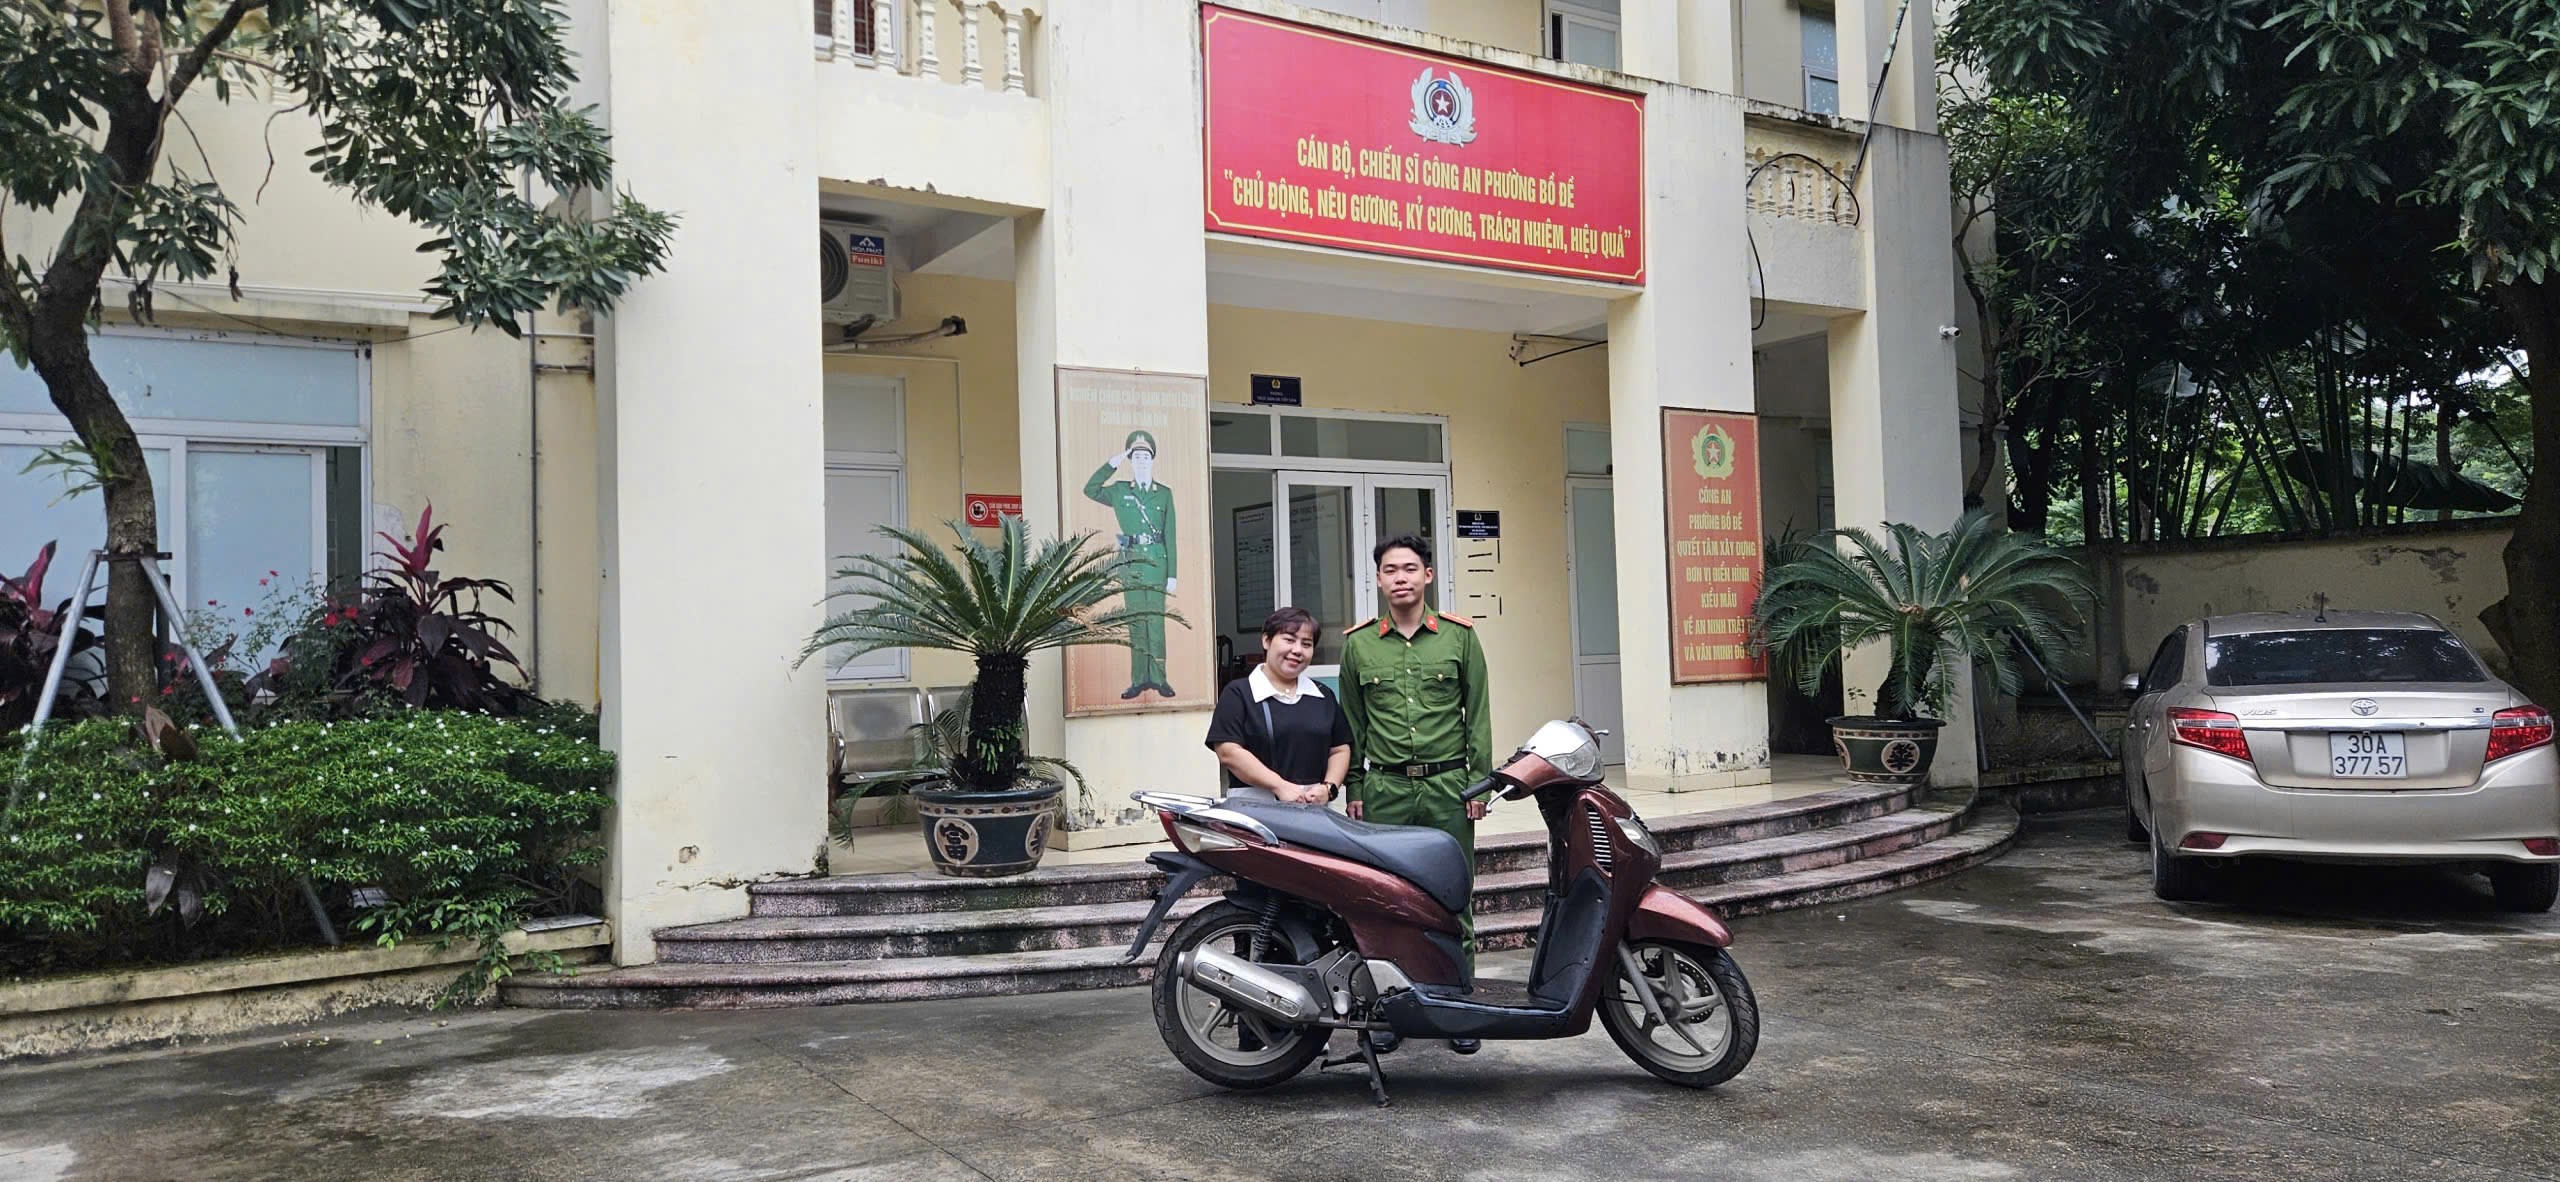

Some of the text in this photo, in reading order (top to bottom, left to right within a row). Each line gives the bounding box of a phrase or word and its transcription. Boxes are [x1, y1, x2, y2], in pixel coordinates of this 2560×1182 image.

[1297, 134, 1329, 170] CÁN
[1332, 140, 1355, 179] BỘ,
[1360, 145, 1401, 182] CHIẾN
[1405, 153, 1420, 184] SĨ
[1422, 156, 1459, 191] CÔNG
[1463, 166, 1481, 195] AN
[1484, 168, 1536, 203] PHƯỜNG
[1268, 178, 1313, 219] ĐỘNG,
[1317, 186, 1346, 220] NÊU
[1351, 193, 1402, 231] GƯƠNG,
[1406, 196, 1423, 231] KỶ
[1427, 206, 1476, 241] CƯƠNG,
[1480, 211, 1520, 245] TRÁCH
[1524, 218, 1567, 254] NHIỆM,
[1570, 223, 1598, 259] HIỆU
[1699, 485, 1731, 505] CÔNG AN
[1689, 511, 1720, 530] PHƯỜNG
[1678, 536, 1756, 560] QUYẾT TÂM XÂY DỰNG
[1686, 565, 1702, 583] ĐƠN
[1703, 566, 1712, 585] VỊ
[1732, 563, 1749, 582] HÌNH
[1695, 619, 1706, 635] AN
[1708, 619, 1726, 634] NINH
[1728, 615, 1745, 637] TRẬT
[1684, 643, 1695, 661] VÀ
[1696, 642, 1712, 661] VĂN
[1713, 644, 1733, 660] MINH
[2348, 734, 2387, 754] 30A
[2334, 756, 2403, 775] 377.57
